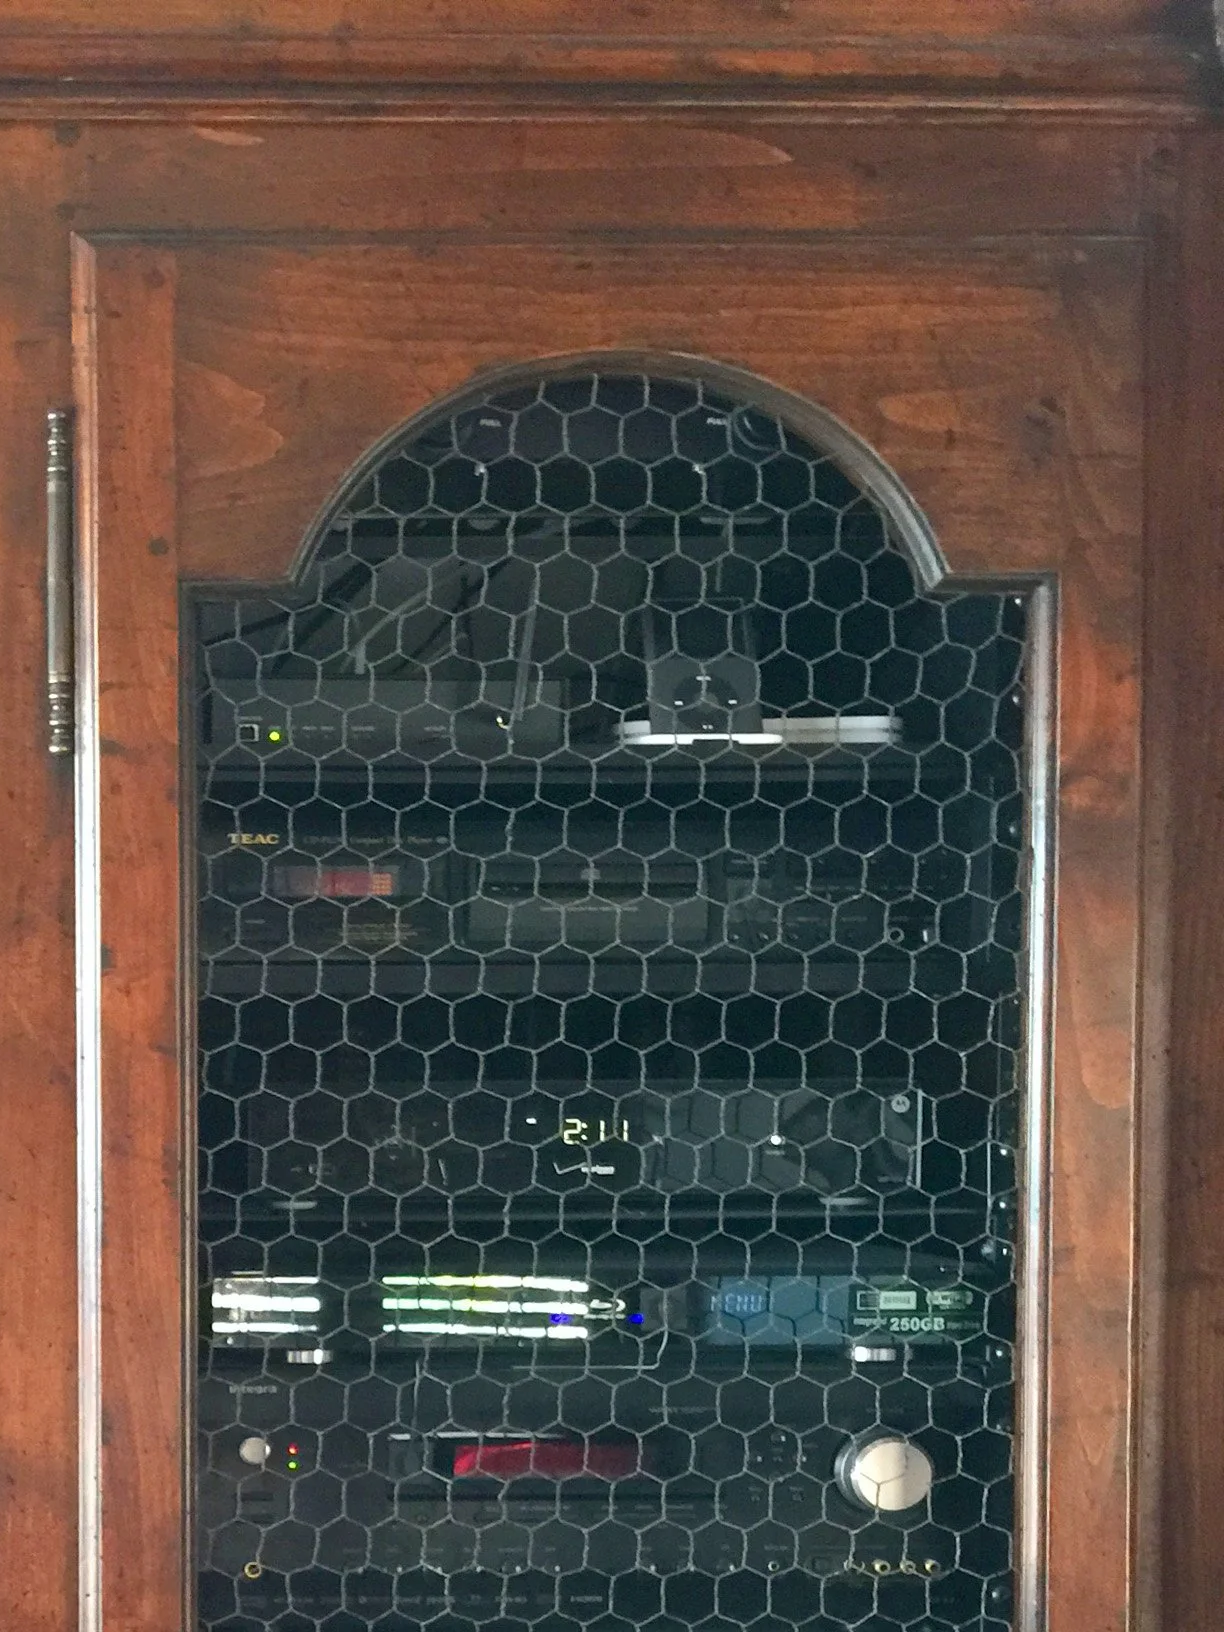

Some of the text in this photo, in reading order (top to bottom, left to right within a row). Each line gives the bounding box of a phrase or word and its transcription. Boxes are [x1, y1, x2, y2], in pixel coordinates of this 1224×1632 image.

[227, 833, 280, 845] TEAC
[563, 1118, 629, 1145] 2:11
[889, 1316, 946, 1332] 250GB
